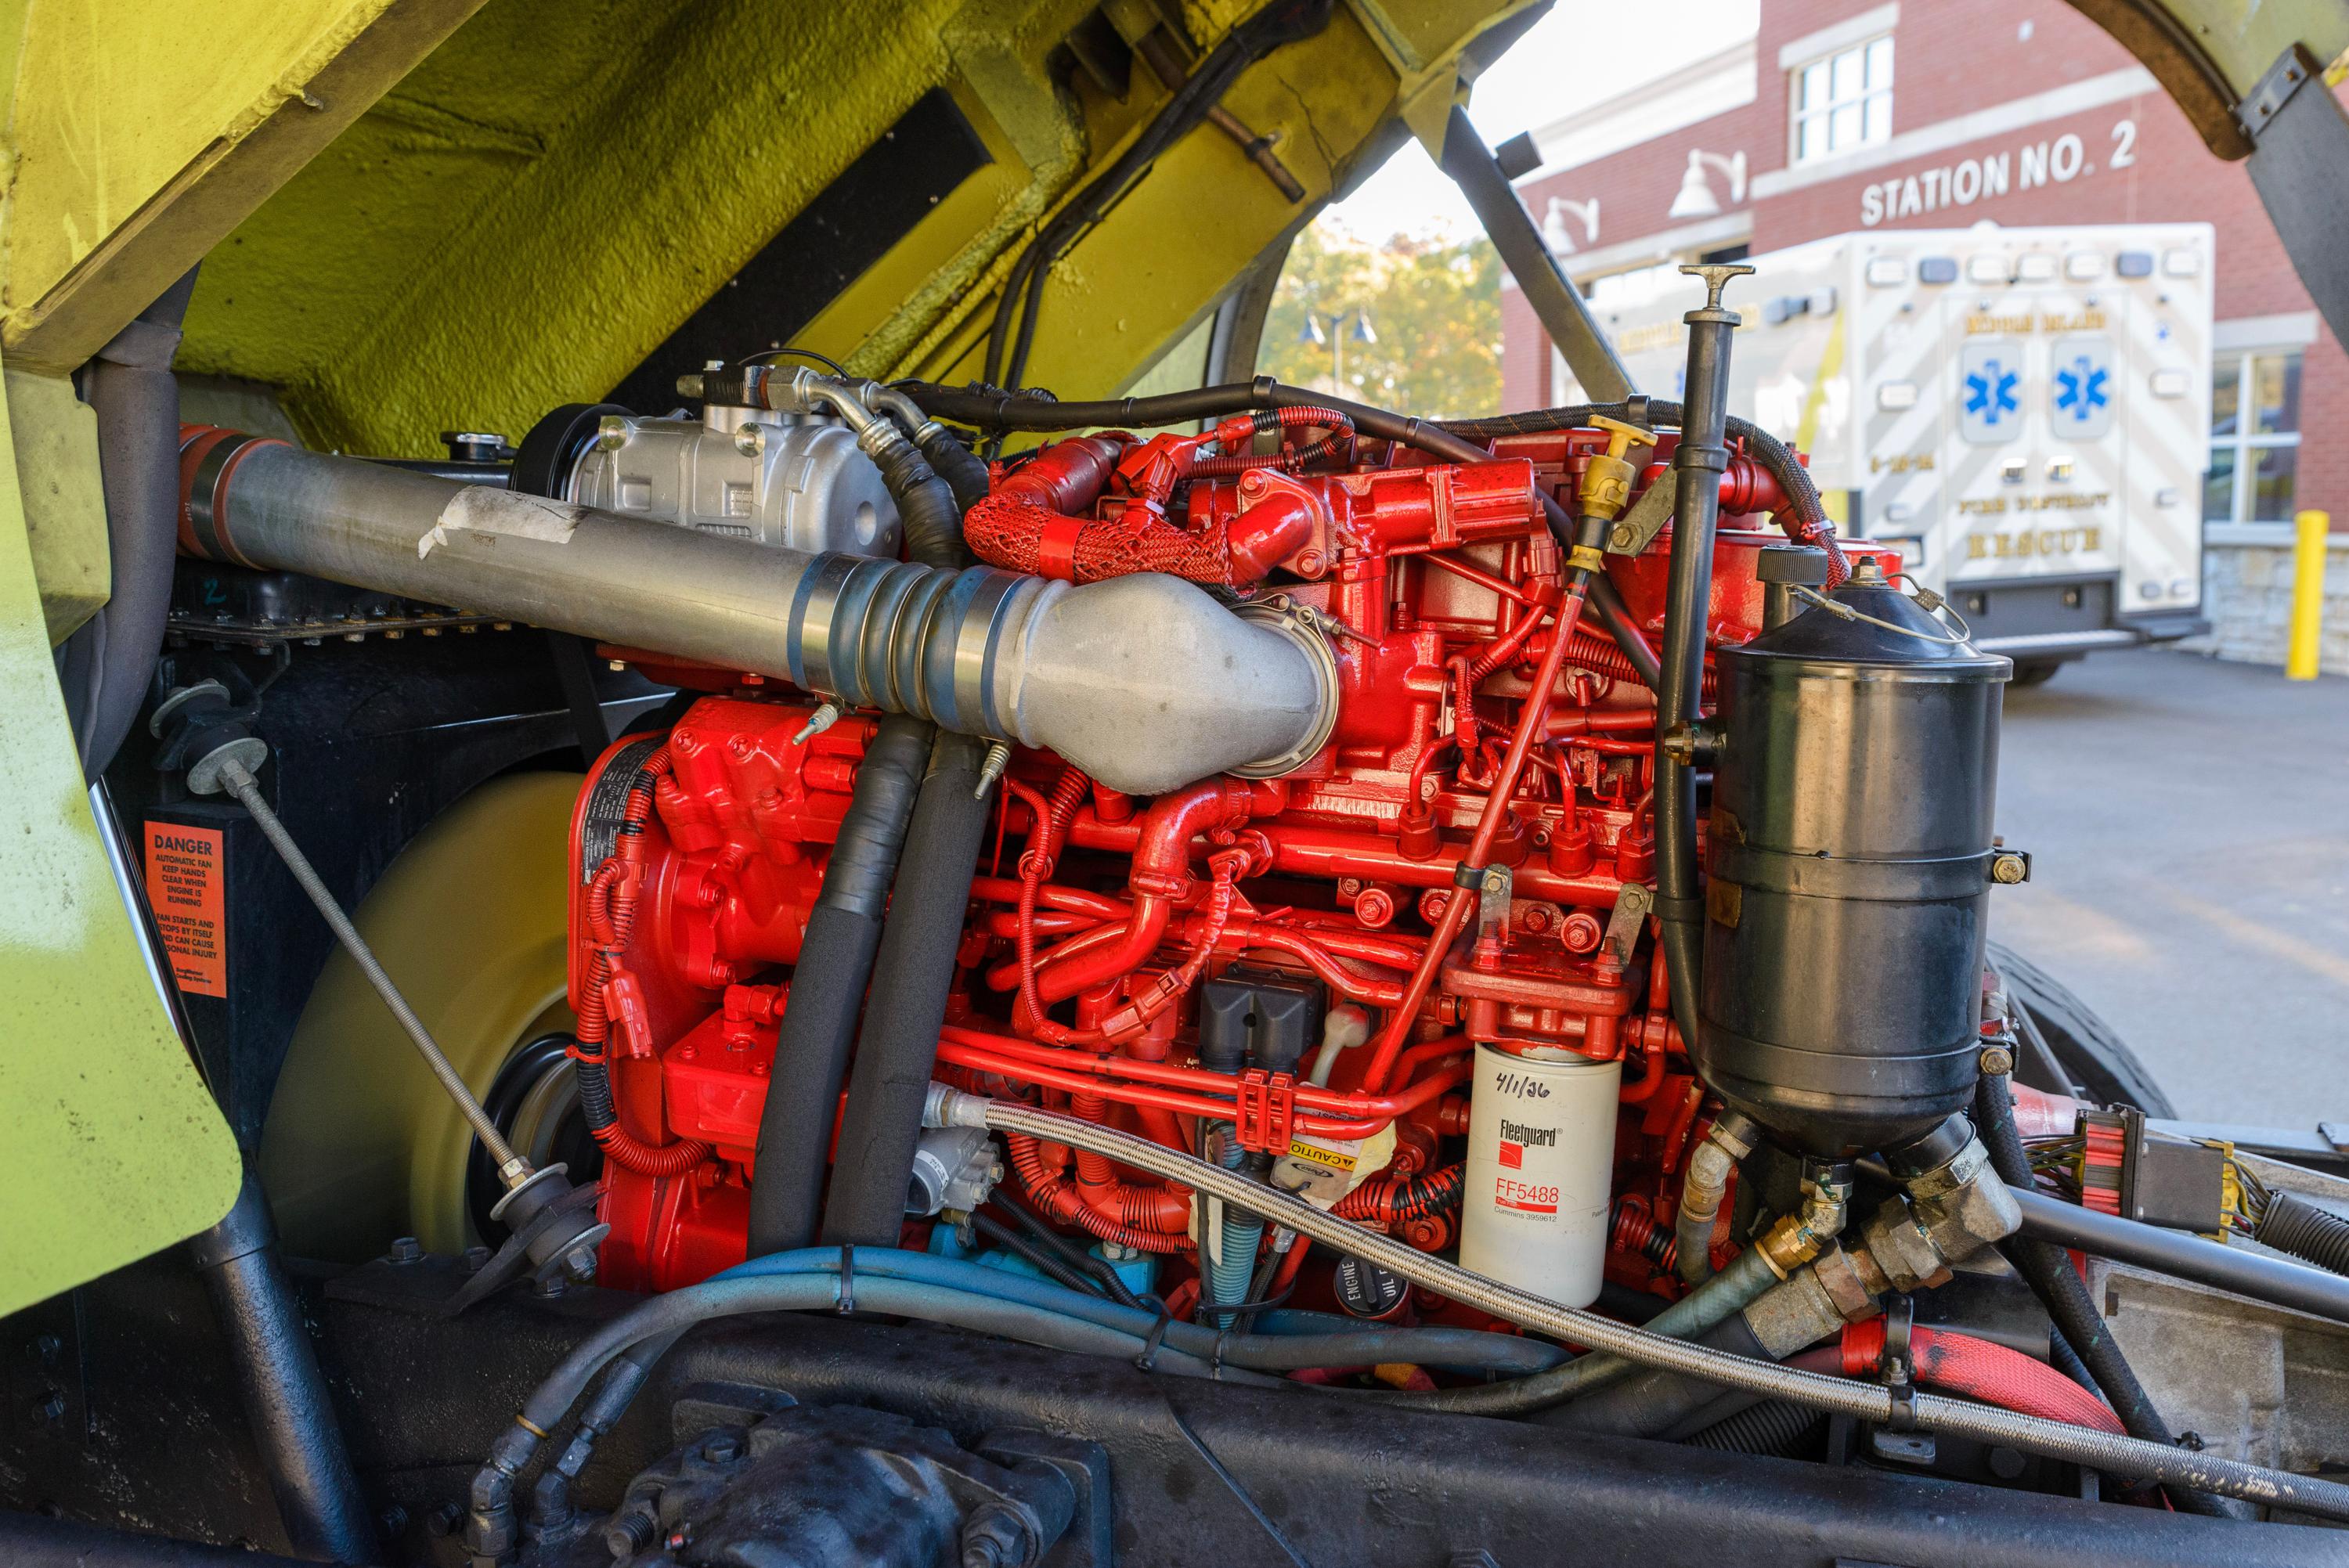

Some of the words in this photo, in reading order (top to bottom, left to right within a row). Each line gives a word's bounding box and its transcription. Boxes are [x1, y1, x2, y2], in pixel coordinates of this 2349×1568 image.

[1860, 151, 2010, 227] STATION
[2019, 132, 2095, 191] NO.
[2109, 119, 2137, 170] 2
[1968, 526, 2102, 559] RESCUE
[154, 834, 213, 856] DANGER
[155, 854, 197, 867] AUTOMATIC
[198, 858, 212, 868] FAN
[162, 864, 179, 874] KEEP
[181, 867, 206, 878] HANDS
[162, 874, 182, 885] CLEAR
[184, 878, 207, 888] WHEN
[167, 885, 193, 896] ENGINE
[195, 889, 202, 897] IS
[167, 895, 202, 907] RUNNING
[156, 914, 171, 922] FAN
[172, 915, 197, 925] STARTS
[198, 920, 215, 928] AND
[193, 929, 214, 939] ITSELF
[175, 935, 190, 945] CAN
[191, 939, 215, 949] CAUSE
[164, 944, 191, 955] SONAL
[192, 949, 218, 959] INJURY
[1291, 1144, 1341, 1165] CAUTIO
[1496, 1177, 1559, 1203] FF5488
[1494, 1206, 1525, 1219] Cummins
[1525, 1213, 1557, 1223] 3959612
[1341, 1260, 1361, 1301] ENGINE
[1381, 1278, 1396, 1298] OIL
